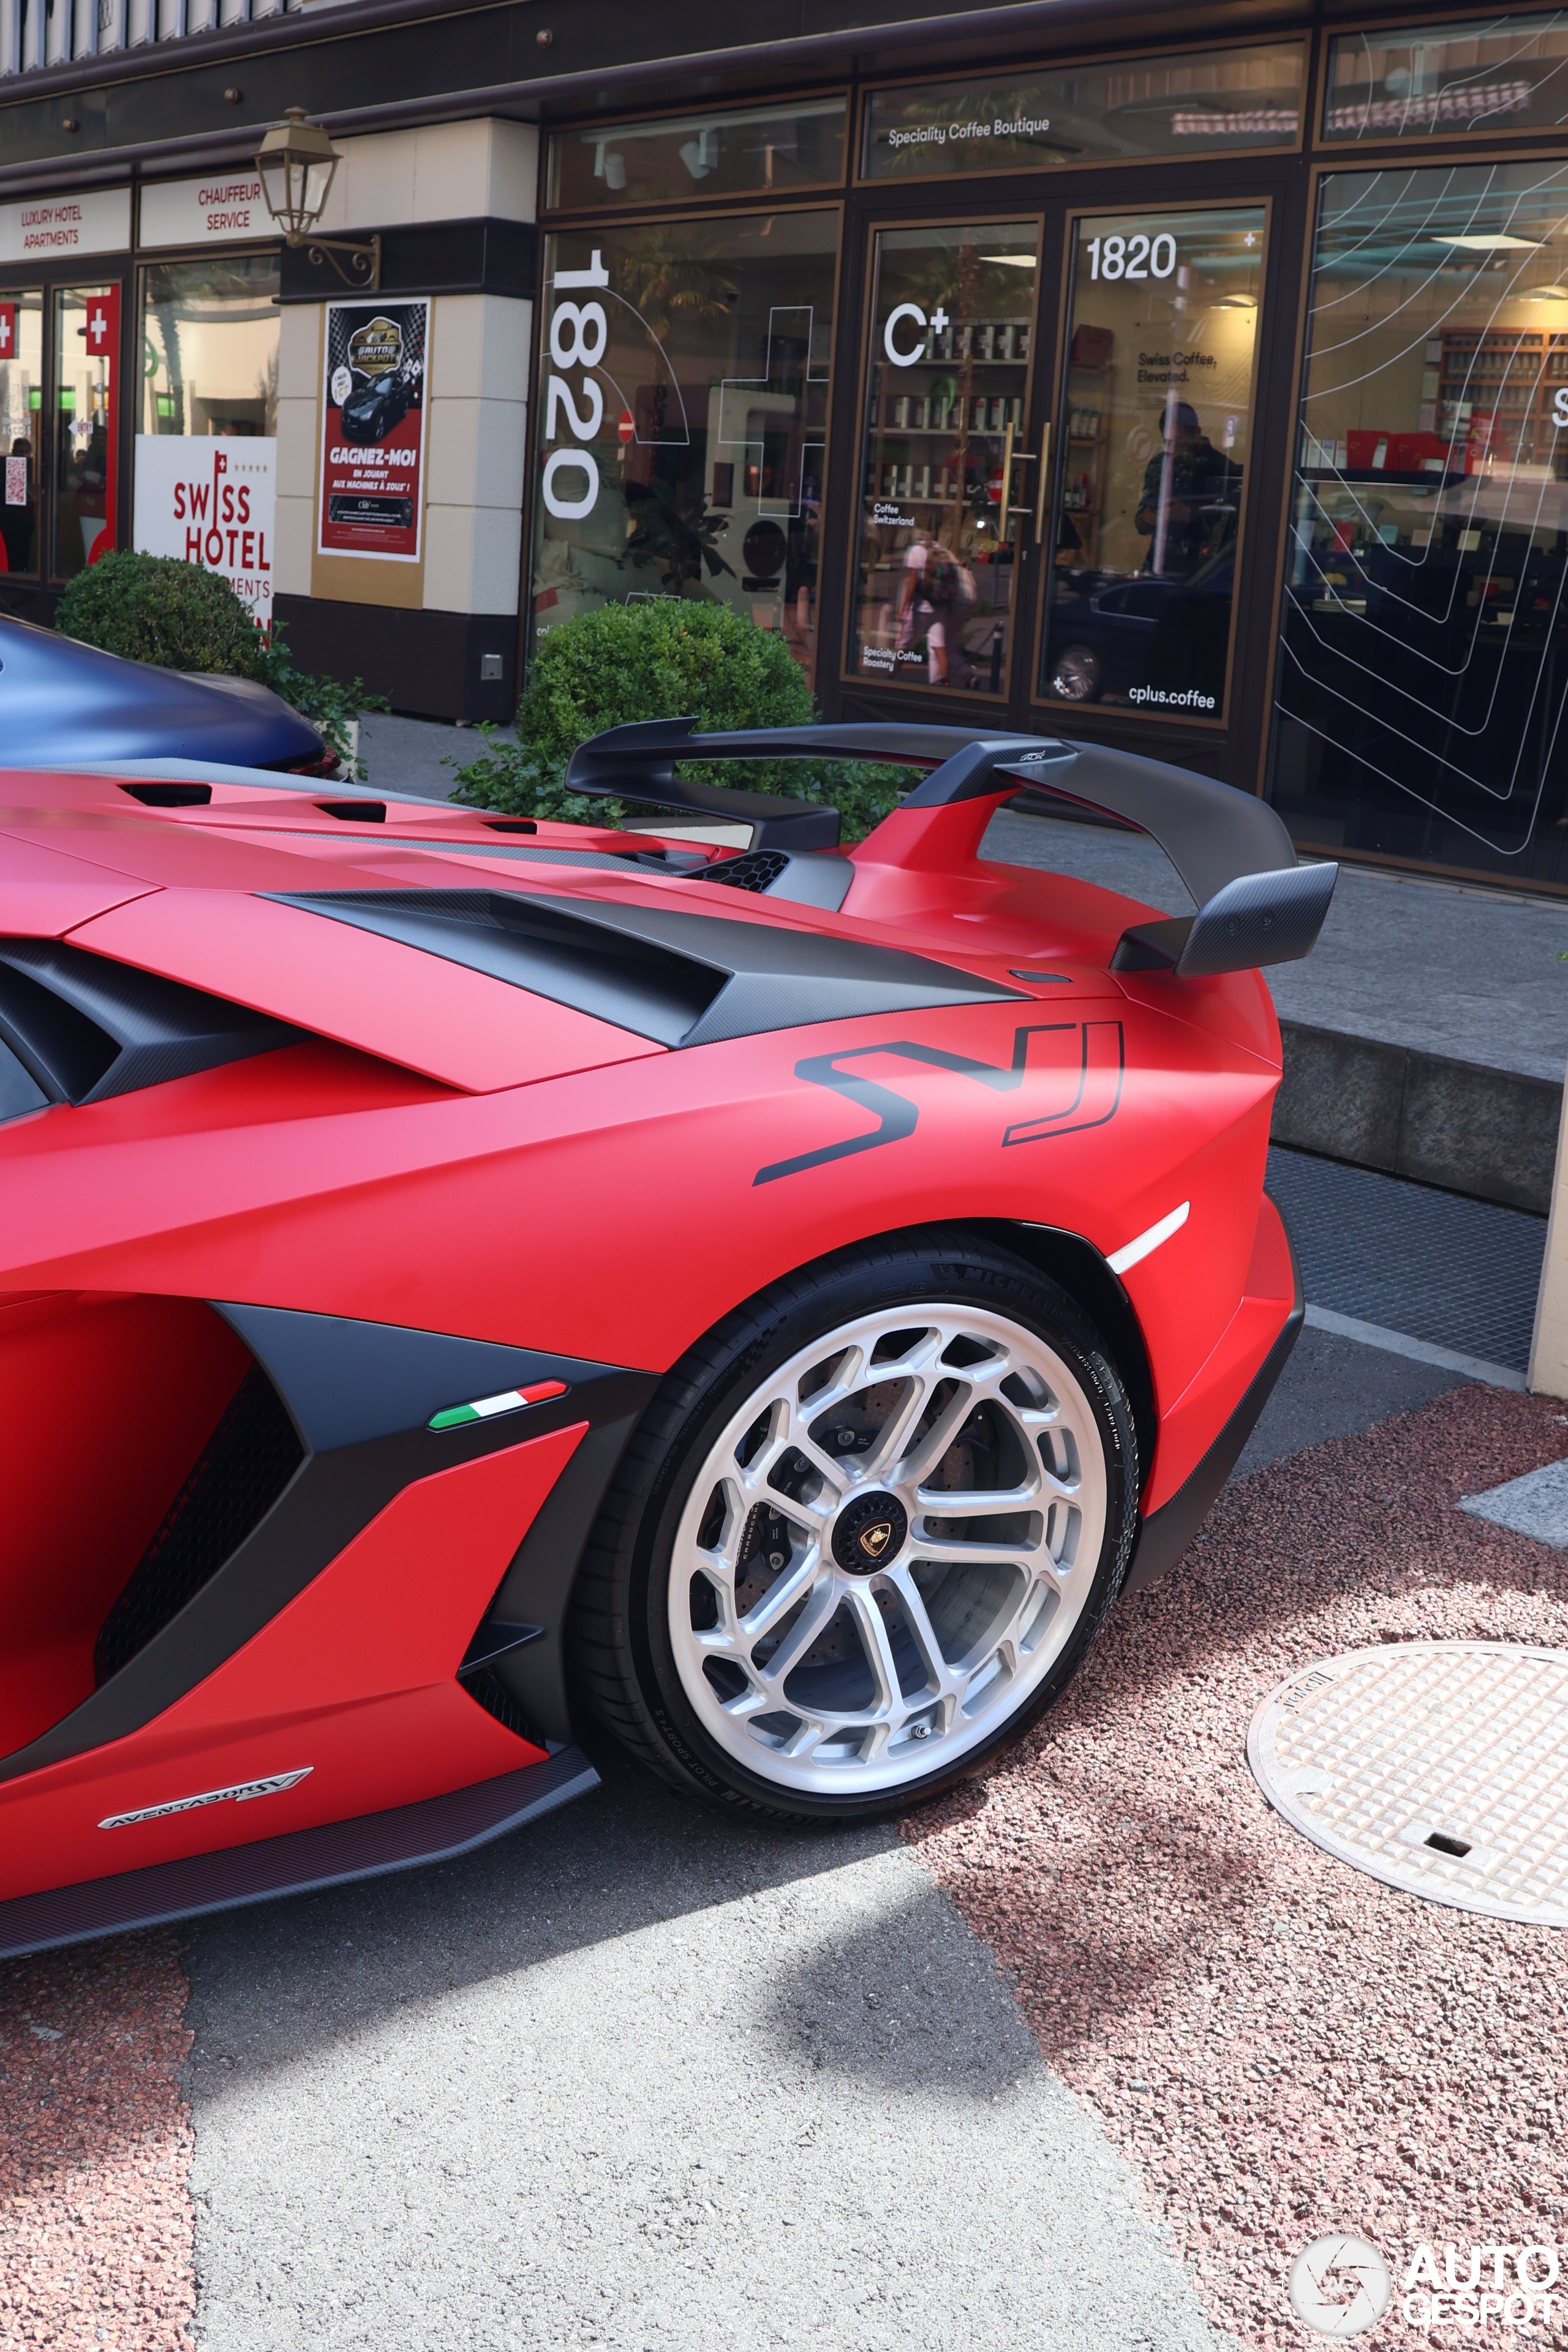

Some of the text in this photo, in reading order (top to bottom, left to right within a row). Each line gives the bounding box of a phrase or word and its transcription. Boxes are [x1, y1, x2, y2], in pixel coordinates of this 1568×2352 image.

[889, 116, 1050, 148] Speciality Coffee Boutique
[198, 183, 260, 205] CHAUFFEUR
[21, 205, 82, 227] LUXURY HOTEL
[206, 211, 250, 230] SERVICE
[23, 229, 78, 249] APARTMENTS
[1087, 233, 1177, 281] 1820
[355, 354, 396, 363] JACKPOT
[364, 346, 388, 354] AUTO
[1138, 351, 1217, 369] Swiss Coffee,
[543, 249, 609, 519] 1820
[1137, 368, 1190, 382] Elevated.
[330, 447, 417, 467] GAGNEZ-MOI
[353, 469, 389, 479] EN JOUANT
[332, 480, 346, 488] AUX
[347, 480, 379, 490] MACHINES
[174, 482, 250, 524] SWISS
[874, 503, 899, 514] Coffee
[873, 513, 915, 526] Switzerland
[186, 526, 270, 570] HOTEL
[864, 645, 922, 662] Specialty Coffee
[863, 656, 894, 672] Roastery
[1129, 684, 1215, 709] cplus.coffee
[964, 1266, 1065, 1320] MICHELIN
[690, 1762, 718, 1787] PILOT
[108, 1785, 256, 1828] AVENTADOR
